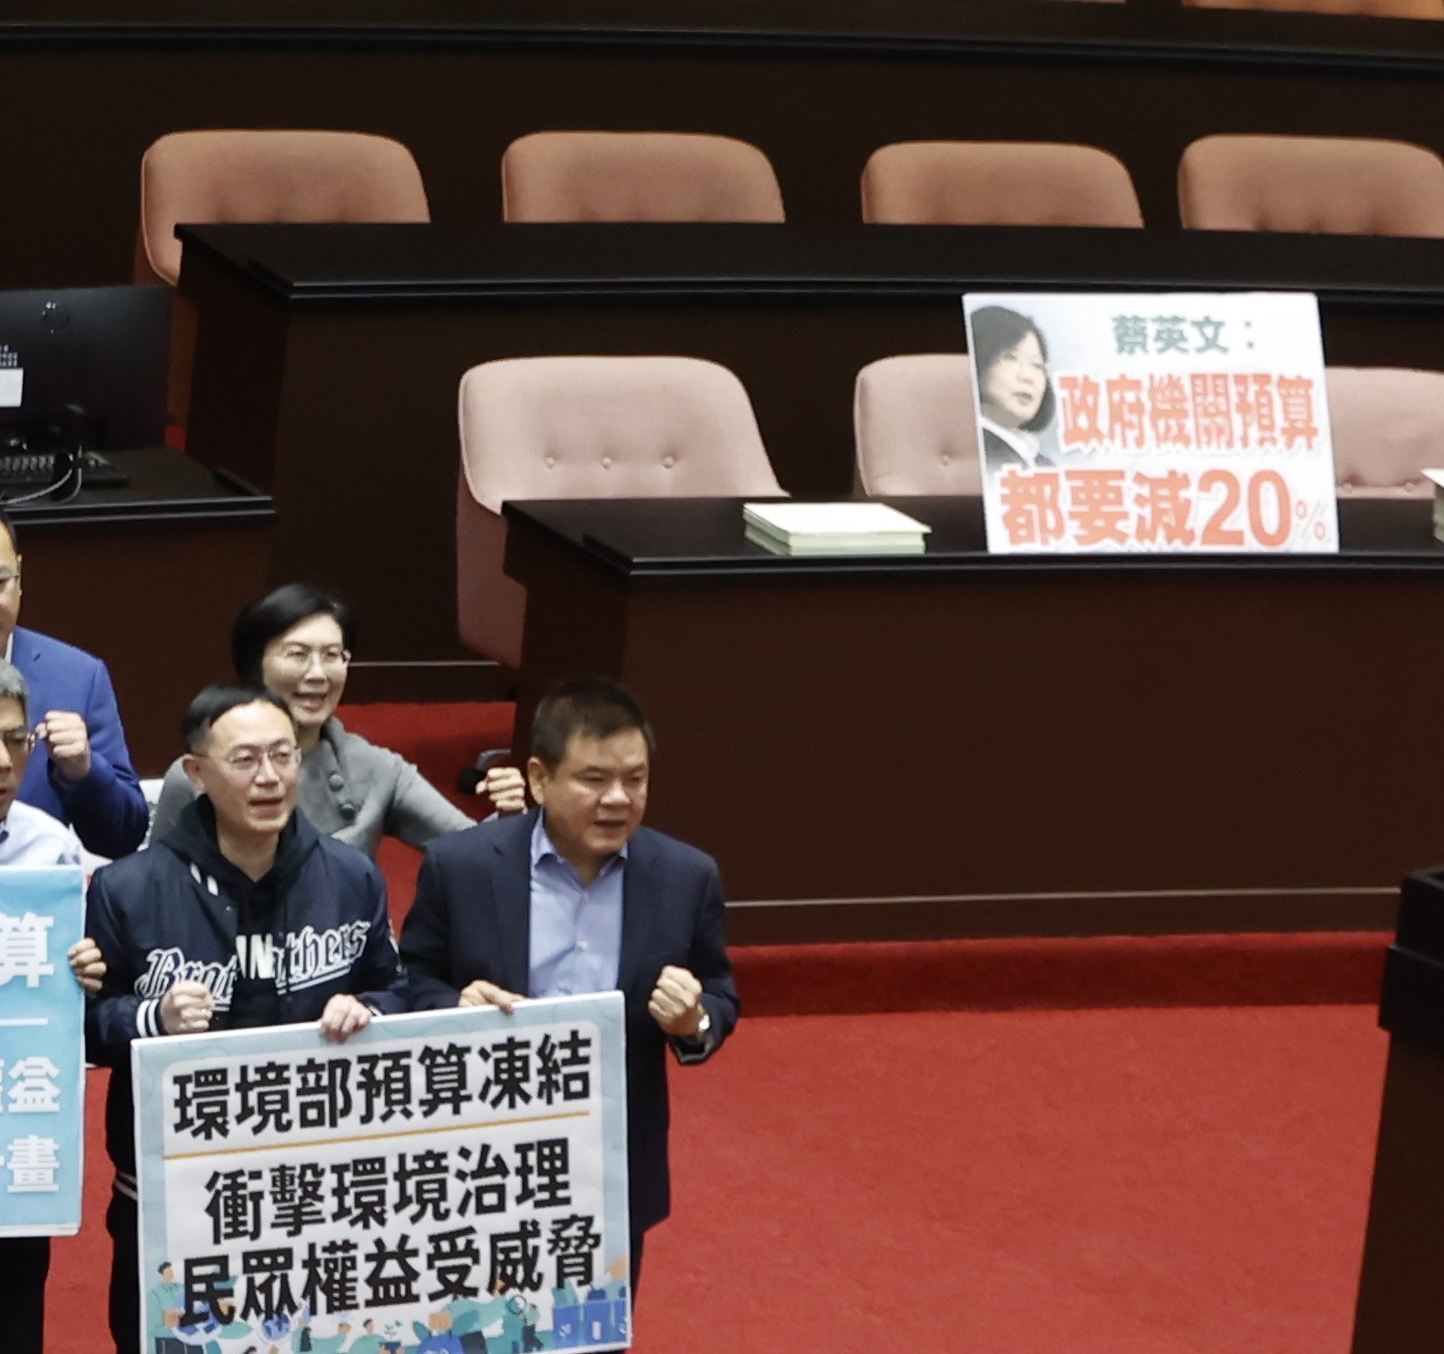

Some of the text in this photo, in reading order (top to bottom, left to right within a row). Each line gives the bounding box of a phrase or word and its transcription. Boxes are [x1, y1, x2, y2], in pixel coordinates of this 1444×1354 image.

[1112, 315, 1255, 354] 蔡英文：
[1059, 373, 1318, 451] 政府機關預算
[173, 1029, 592, 1140] 環境部預算凍結
[205, 1137, 571, 1245] 衝擊環境治理
[181, 1213, 602, 1327] 民眾權益受威脅
